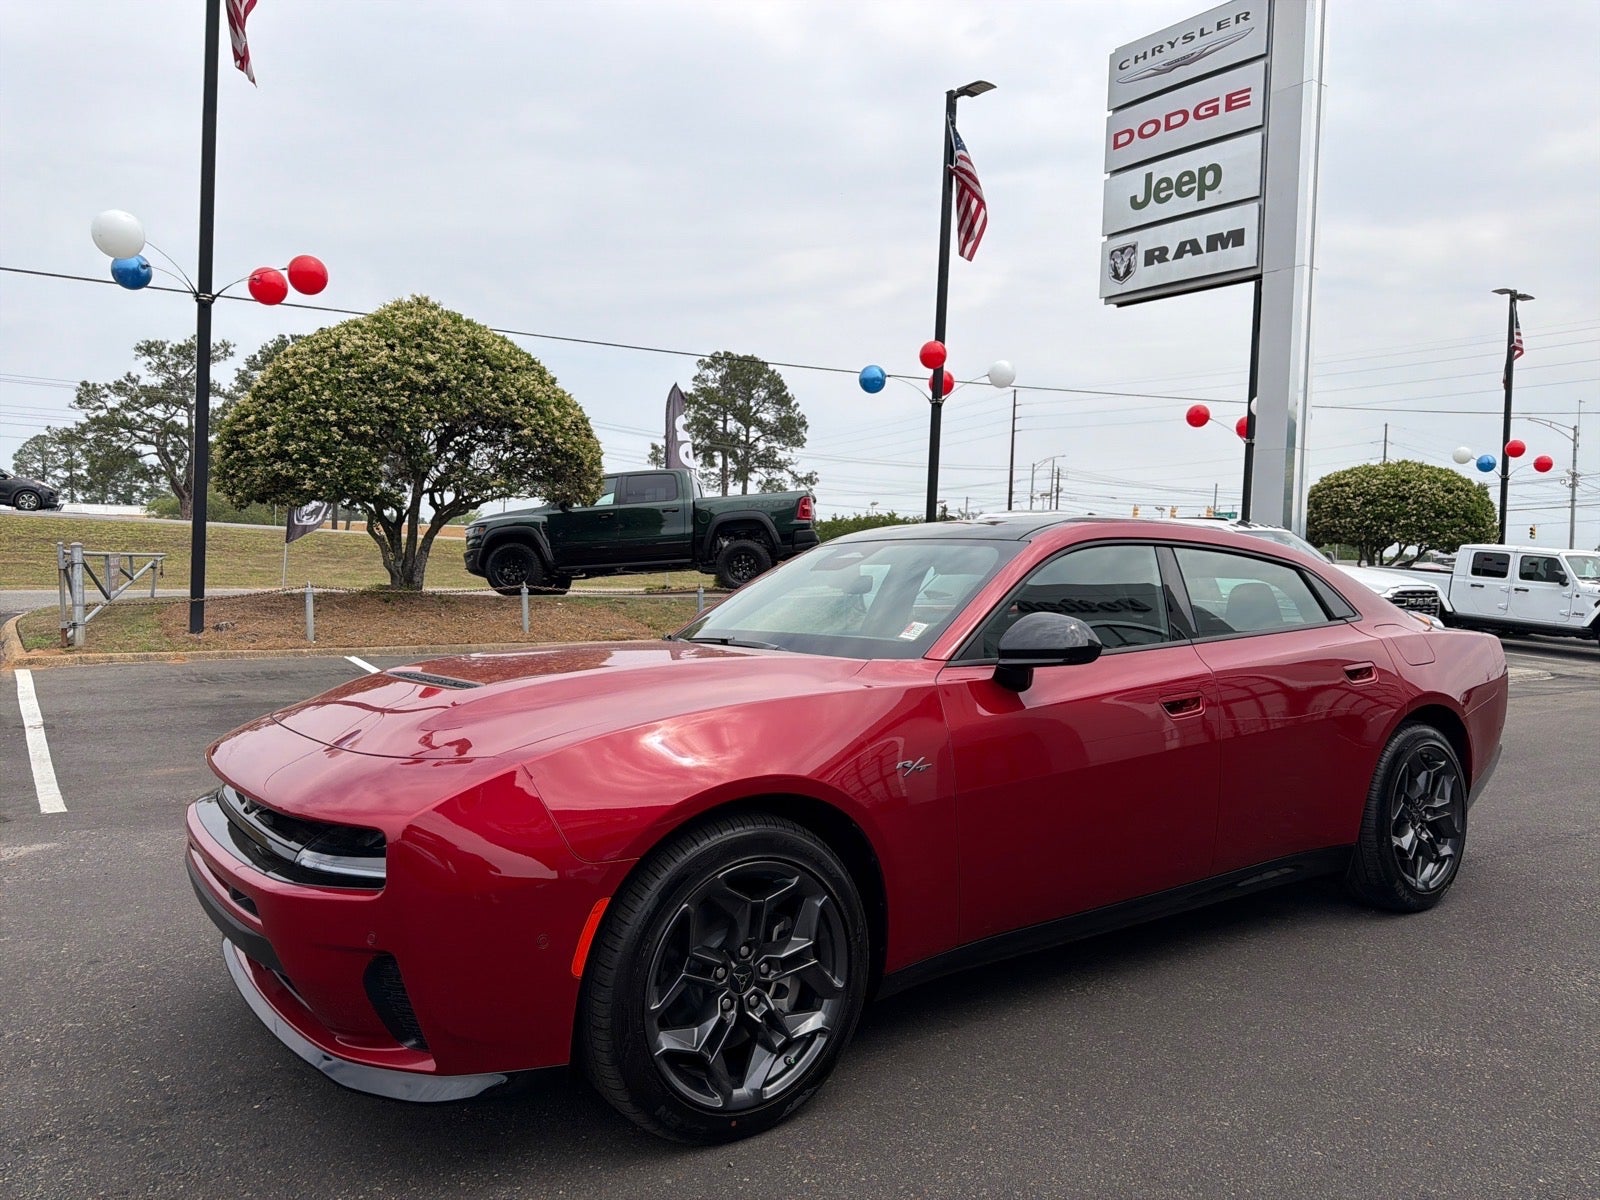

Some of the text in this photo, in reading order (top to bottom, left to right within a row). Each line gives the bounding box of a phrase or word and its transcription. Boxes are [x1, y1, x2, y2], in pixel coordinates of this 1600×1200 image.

[1118, 11, 1251, 71] CHRYSLER
[1113, 87, 1252, 150] DODGE
[1129, 162, 1223, 211] Jeep
[1143, 227, 1246, 268] RAM
[1408, 597, 1432, 606] RAM
[895, 756, 933, 777] R/T
